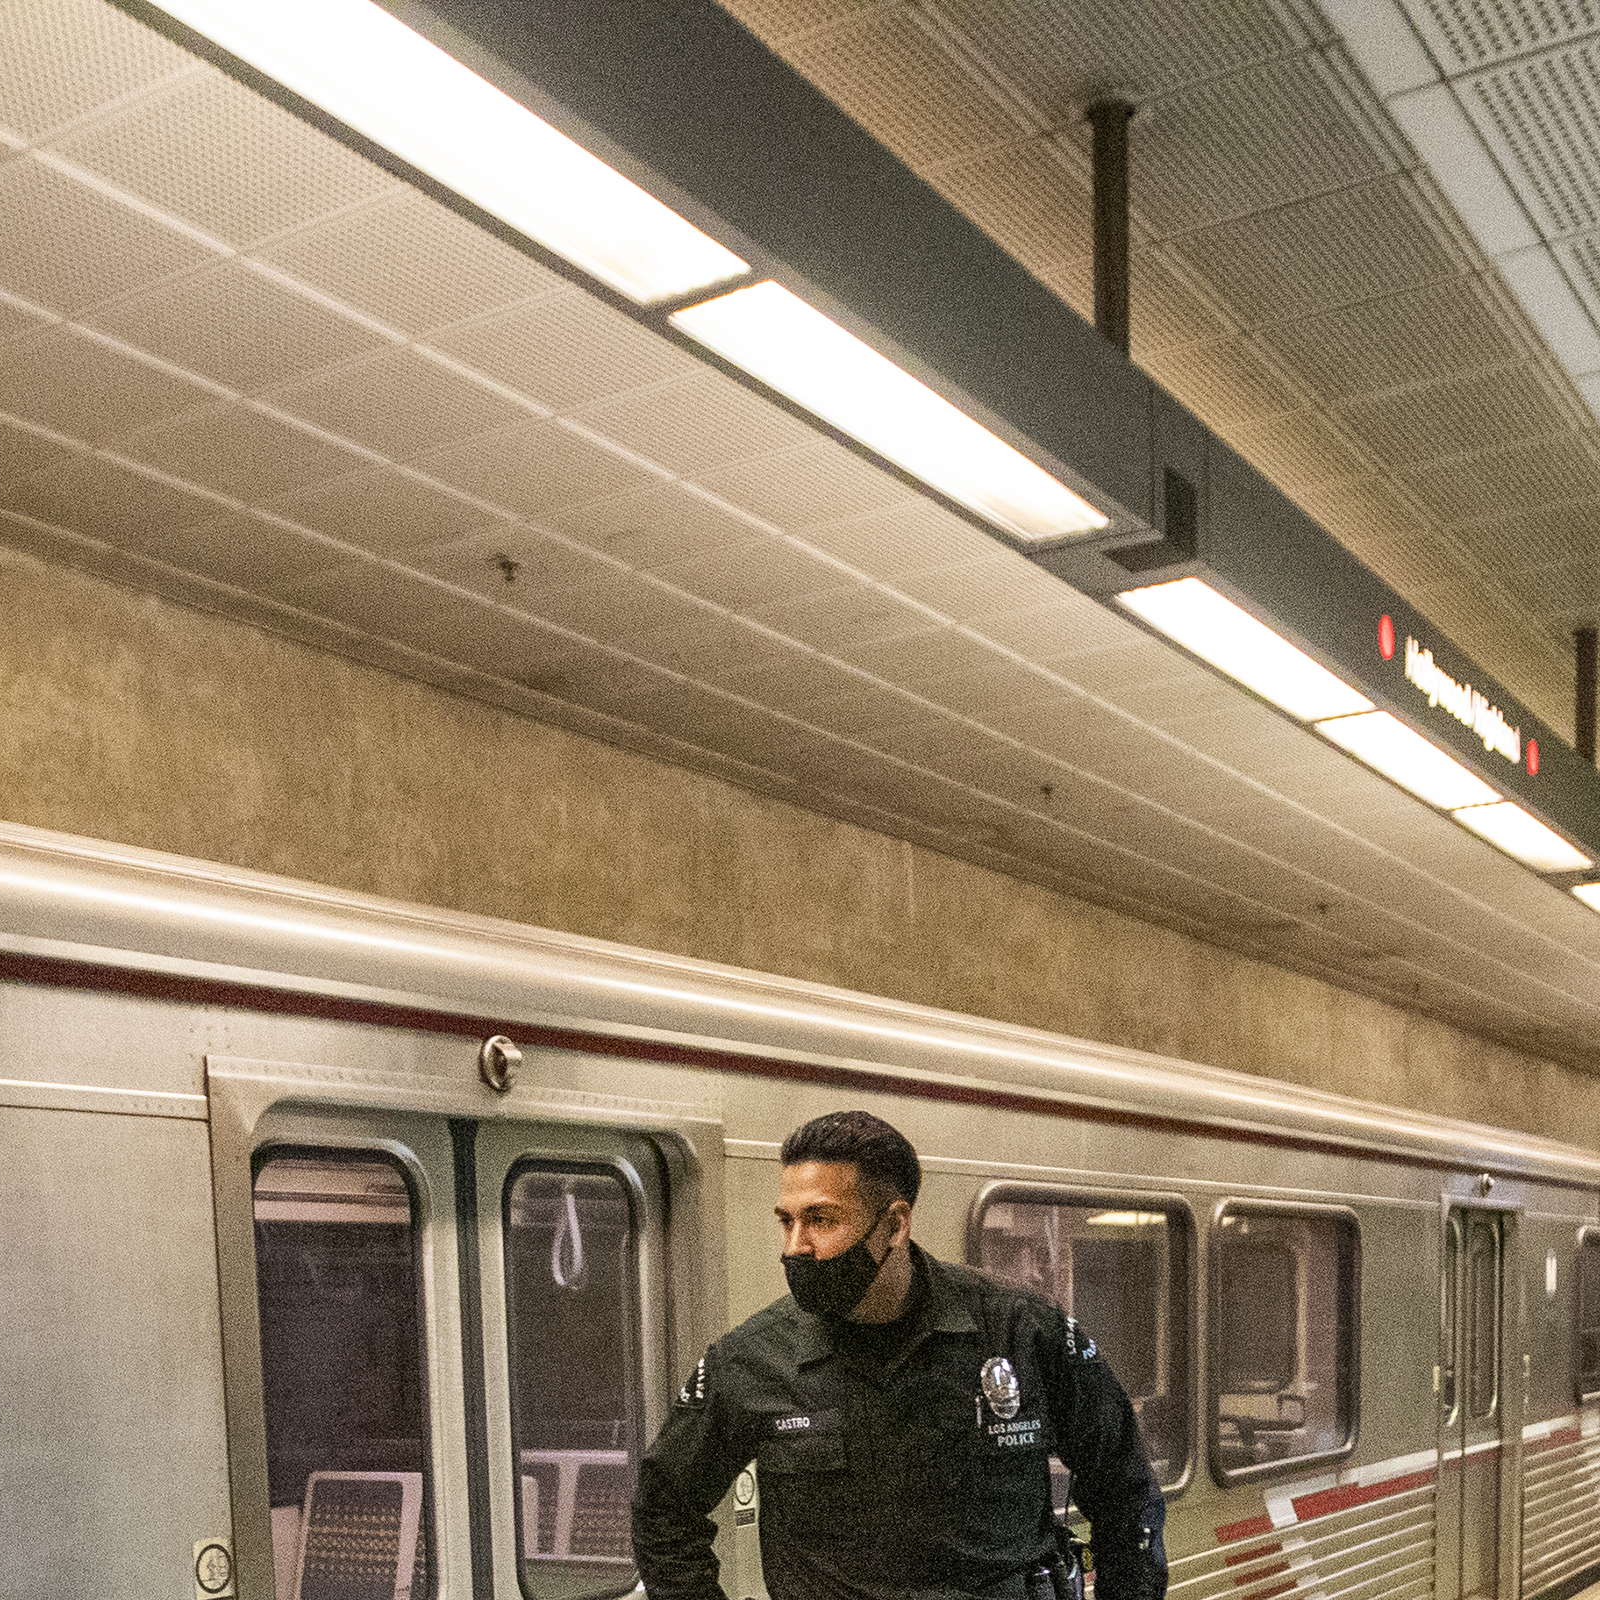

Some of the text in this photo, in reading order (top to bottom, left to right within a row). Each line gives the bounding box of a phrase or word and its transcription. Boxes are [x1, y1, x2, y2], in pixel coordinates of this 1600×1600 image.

[988, 1418, 1042, 1435] LOS ANGELES
[997, 1432, 1036, 1447] POLICE
